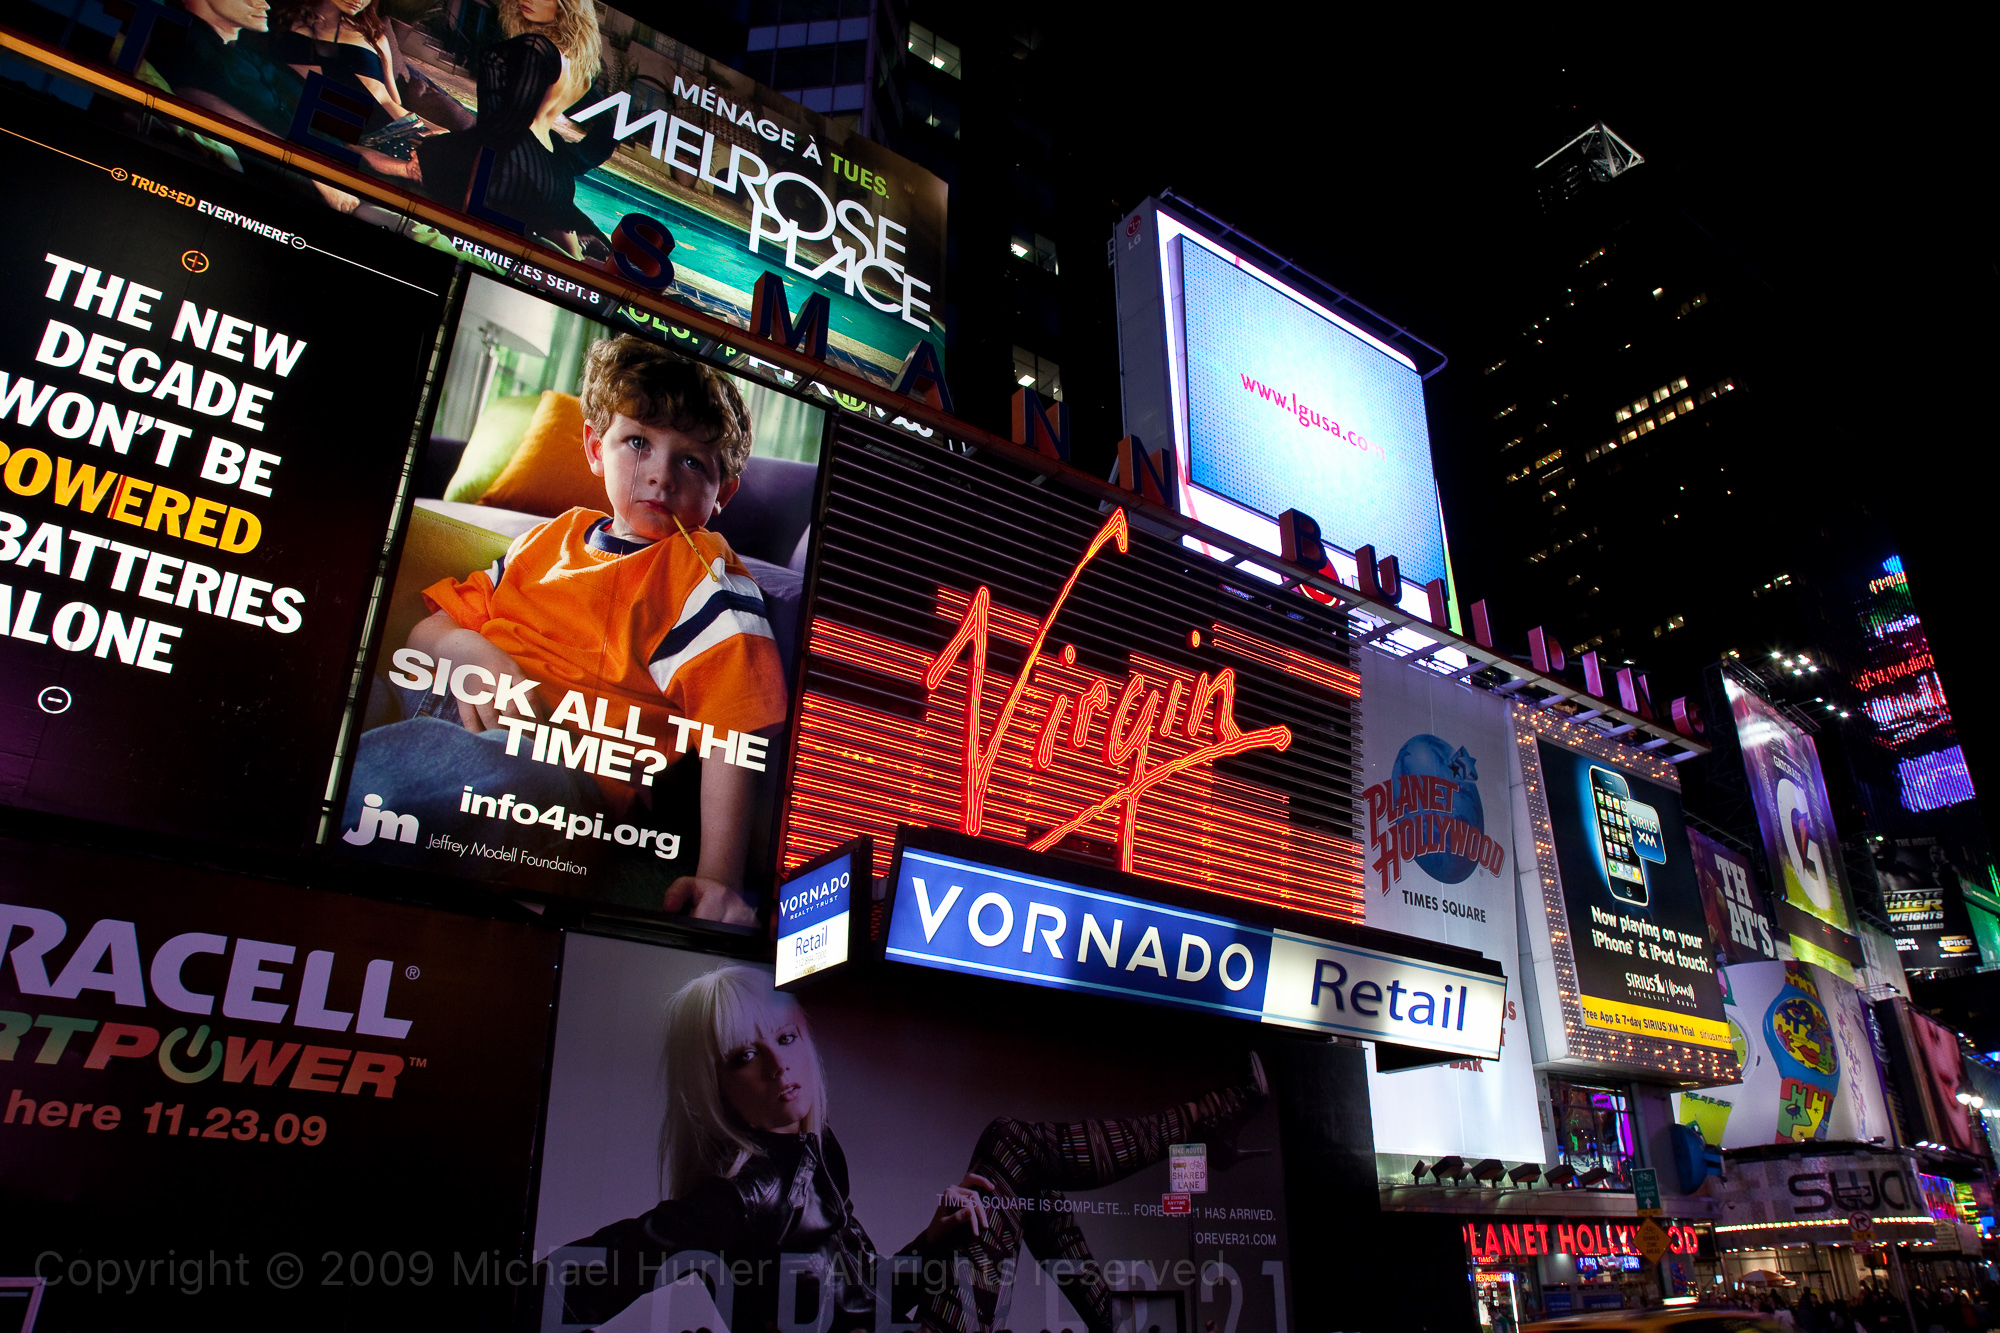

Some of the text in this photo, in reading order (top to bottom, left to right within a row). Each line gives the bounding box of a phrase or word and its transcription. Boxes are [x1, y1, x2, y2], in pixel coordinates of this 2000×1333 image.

[672, 75, 890, 200] MÉNAGE À TUES.
[571, 90, 906, 262] MELROSE
[749, 203, 932, 332] PLACE
[1128, 234, 1141, 250] LG
[44, 253, 307, 377] THE NEW
[546, 274, 587, 300] SEPT.
[589, 291, 600, 305] 8
[35, 319, 273, 431] DECADE
[200, 436, 282, 497] BE
[0, 511, 305, 634] BATTERIES
[388, 646, 768, 772] SICK ALL THE
[922, 506, 1292, 873] Virgin
[498, 715, 667, 787] TIME?
[342, 793, 419, 847] jm
[459, 785, 681, 859] info4pi.org
[1362, 775, 1460, 851] PLANET
[1631, 814, 1657, 833] SIRIUS
[1636, 830, 1658, 848] XM
[426, 832, 587, 877] Jeffrey Modell Foundation
[1372, 814, 1504, 896] HOLLYWOOD
[1777, 778, 1831, 910] G
[780, 872, 849, 917] VORNADO
[790, 895, 838, 920] REALTY TRUST
[1402, 890, 1486, 923] TIMES SQUARE
[1714, 852, 1753, 908] TH
[795, 925, 827, 956] Retail
[911, 876, 1254, 992] VORNADO
[1591, 905, 1703, 949] Now playing on your
[1638, 941, 1649, 959] &
[1650, 942, 1675, 965] iPod
[1726, 899, 1775, 958] AT'S
[0, 904, 413, 1039] RACELL
[1311, 958, 1467, 1031] Retail
[1625, 972, 1655, 991] SIRIUS
[1582, 1007, 1598, 1020] Free
[1600, 1012, 1613, 1024] App
[1615, 1013, 1620, 1024] &
[1622, 1014, 1642, 1030] 7-day
[1643, 1018, 1667, 1033] SIRIUS
[1668, 1021, 1679, 1035] XM
[1680, 1025, 1695, 1038] Trial
[3, 1089, 329, 1147] here 11.23.09
[1172, 1171, 1205, 1180] SHARED
[1178, 1181, 1200, 1189] LANE
[937, 1194, 978, 1211] TIMES
[982, 1195, 1034, 1213] SQUARE
[1039, 1198, 1050, 1213] IS
[1053, 1199, 1130, 1217] COMPLETE...
[1204, 1207, 1226, 1219] HAS
[1229, 1208, 1276, 1222] ARRIVED.
[1462, 1222, 1548, 1256] LANET
